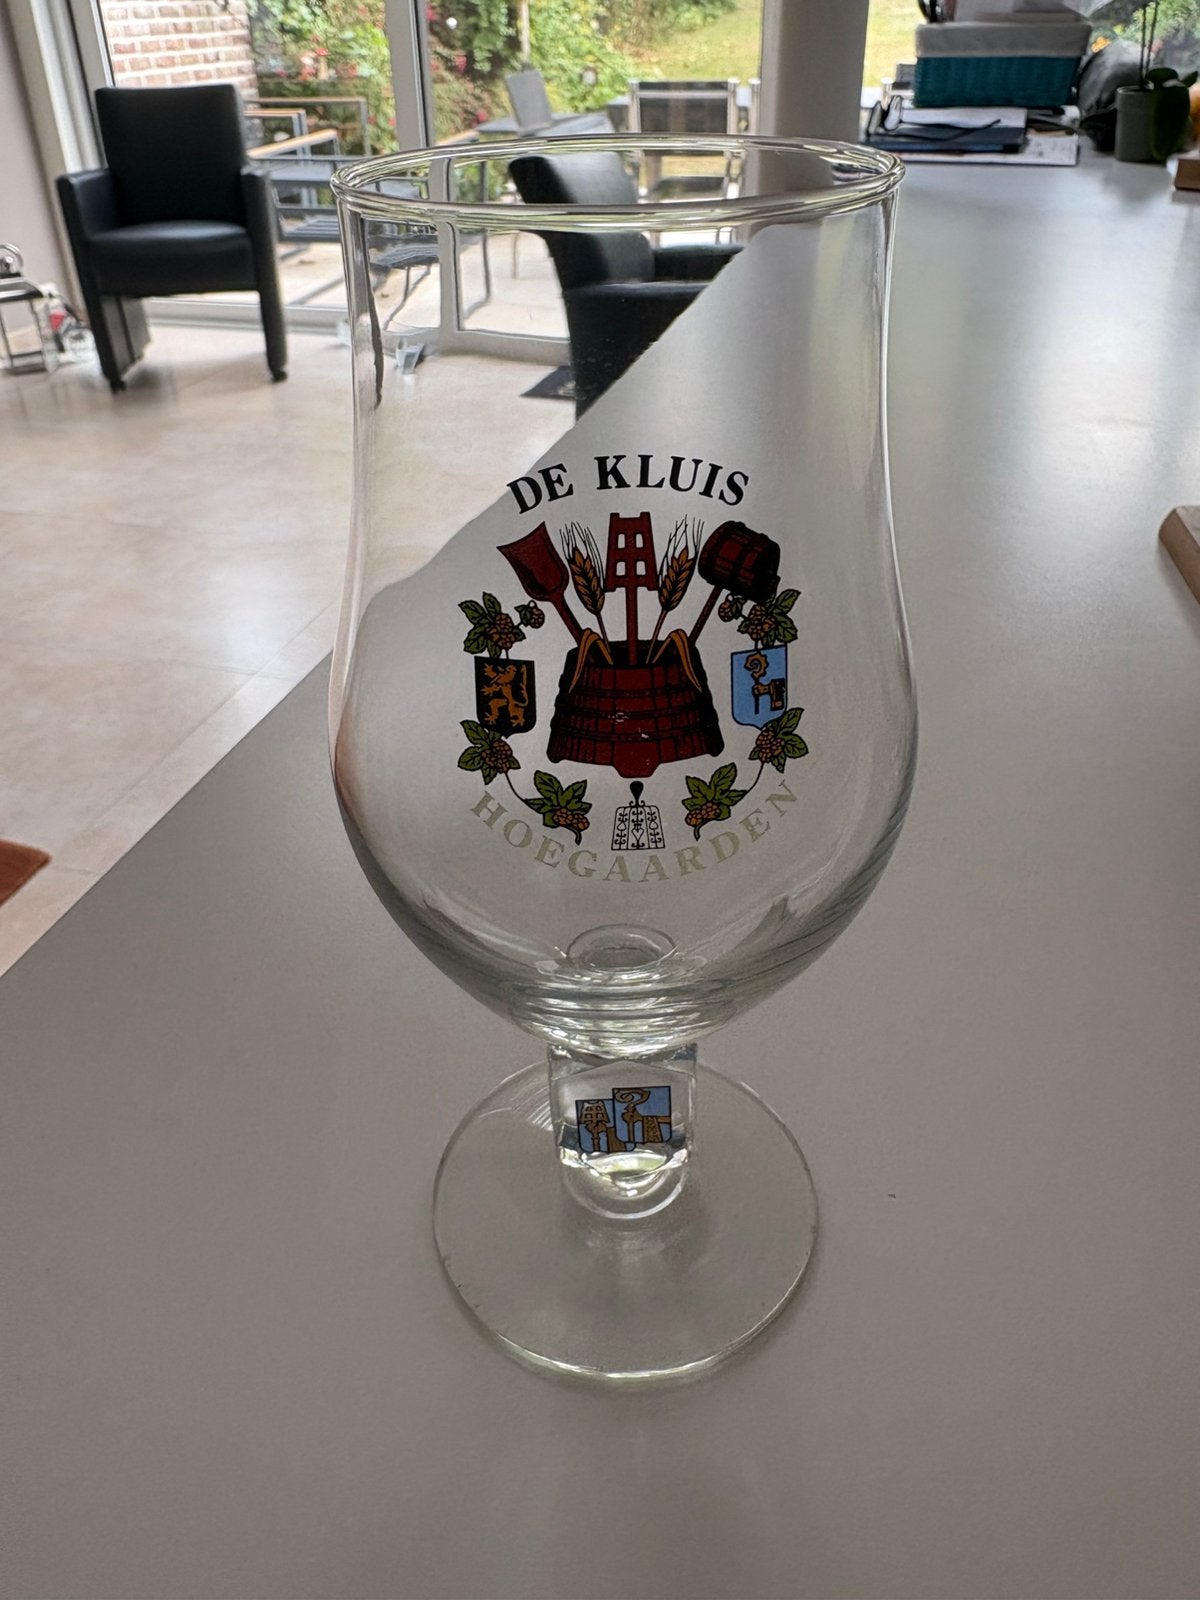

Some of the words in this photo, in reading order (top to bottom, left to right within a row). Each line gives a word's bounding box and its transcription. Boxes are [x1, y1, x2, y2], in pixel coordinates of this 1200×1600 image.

[507, 463, 574, 514] DE
[594, 454, 750, 506] KLUIS
[469, 779, 800, 883] HOEGAARDEN
